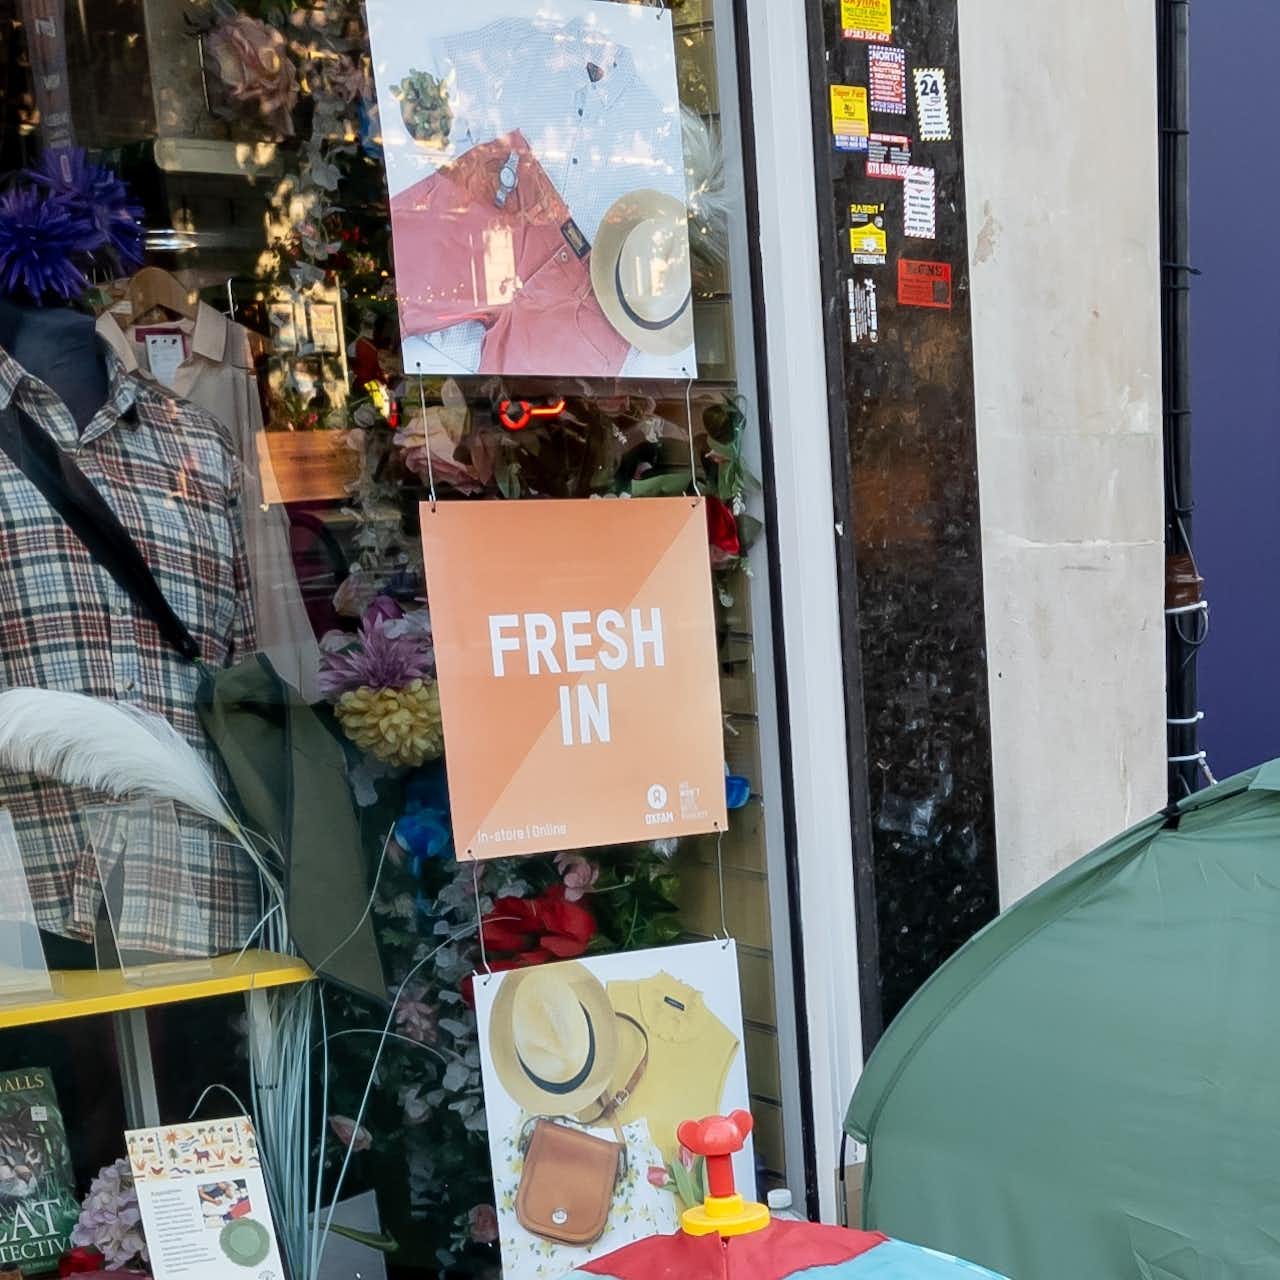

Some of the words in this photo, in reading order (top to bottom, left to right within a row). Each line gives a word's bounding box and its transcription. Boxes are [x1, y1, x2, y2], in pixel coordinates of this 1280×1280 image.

[872, 51, 901, 62] NORTH
[920, 80, 940, 96] 24
[488, 607, 665, 677] FRESH
[559, 682, 611, 746] IN
[645, 811, 674, 825] OXFAM
[477, 826, 525, 843] In-store
[532, 822, 568, 839] Online
[0, 1073, 45, 1092] ALLS
